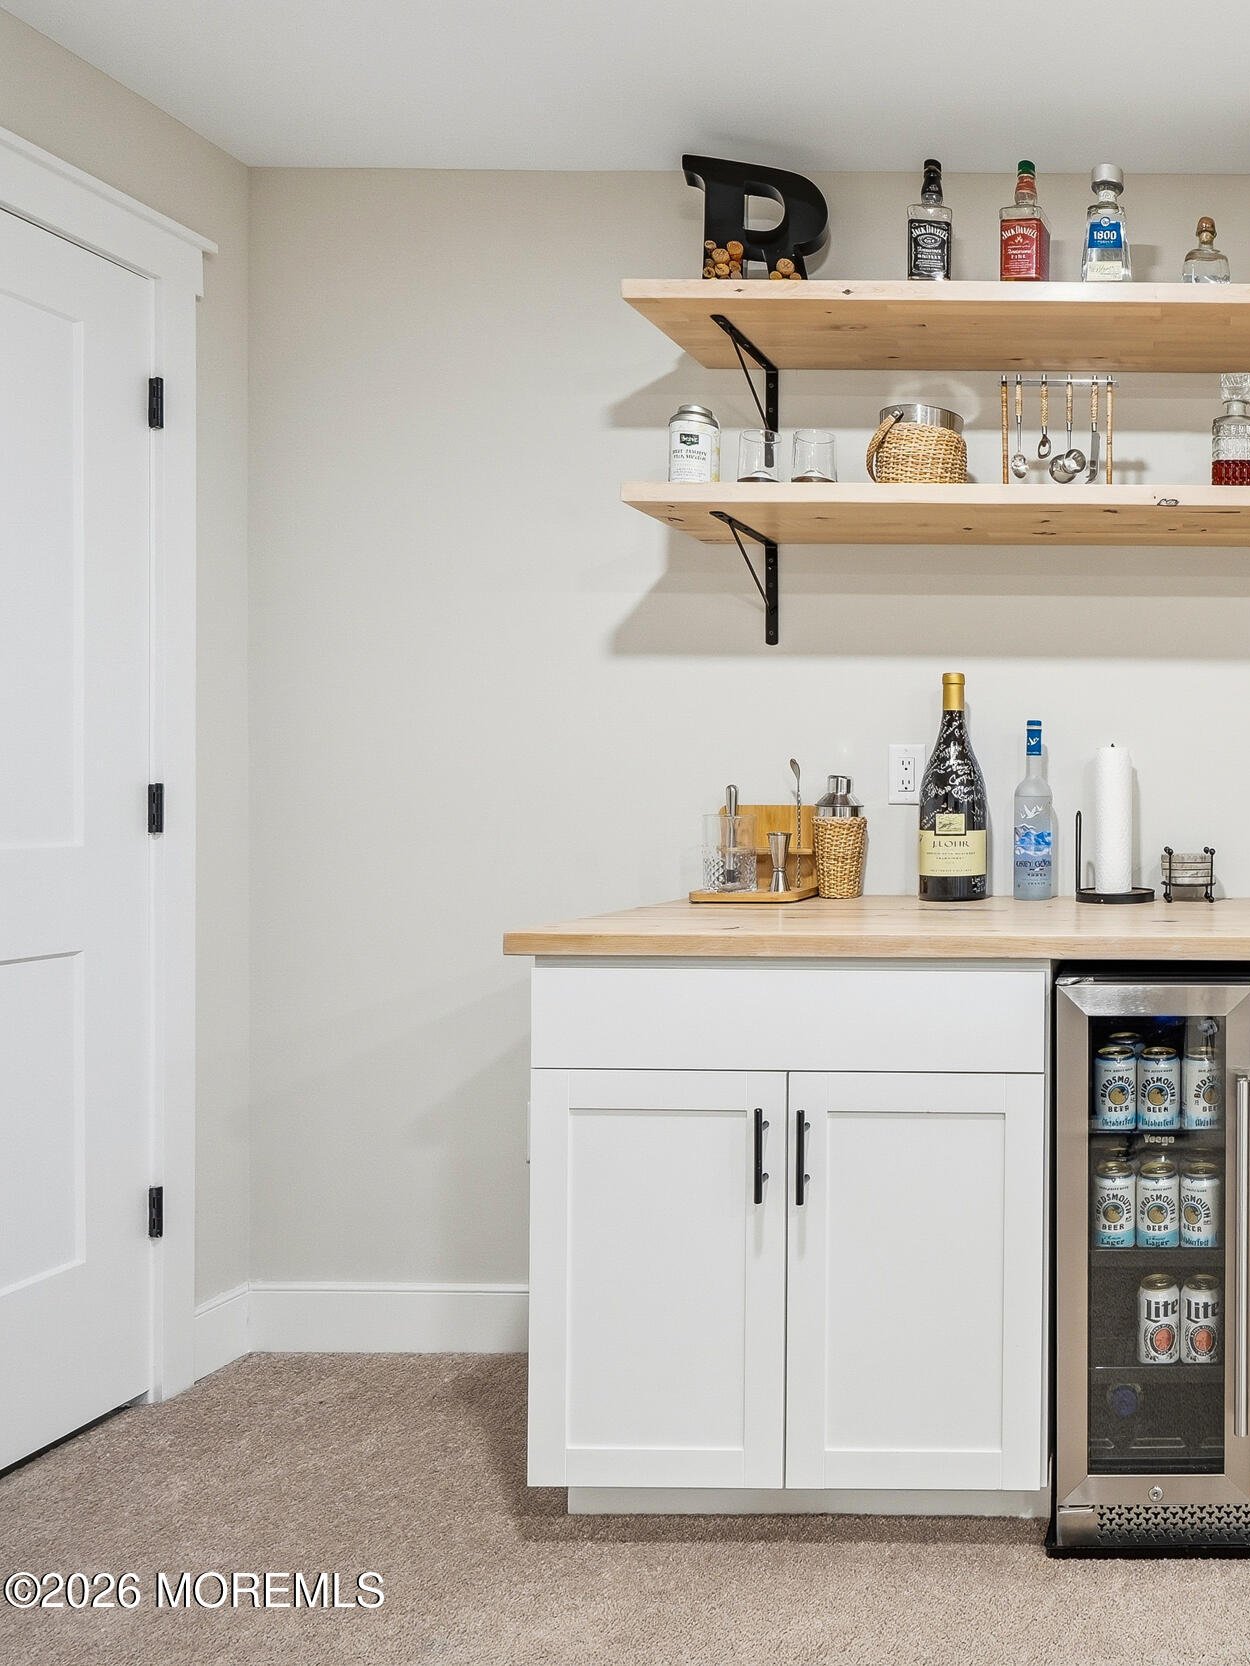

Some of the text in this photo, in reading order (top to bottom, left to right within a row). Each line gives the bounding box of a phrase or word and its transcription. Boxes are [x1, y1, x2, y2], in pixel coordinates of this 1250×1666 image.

[1093, 230, 1117, 240] 1800
[1101, 1076, 1135, 1098] BIRDSMOUTH
[1141, 1076, 1176, 1098] BIRDSMOUTH
[1145, 1298, 1179, 1324] Lite
[1186, 1298, 1220, 1324] Lite
